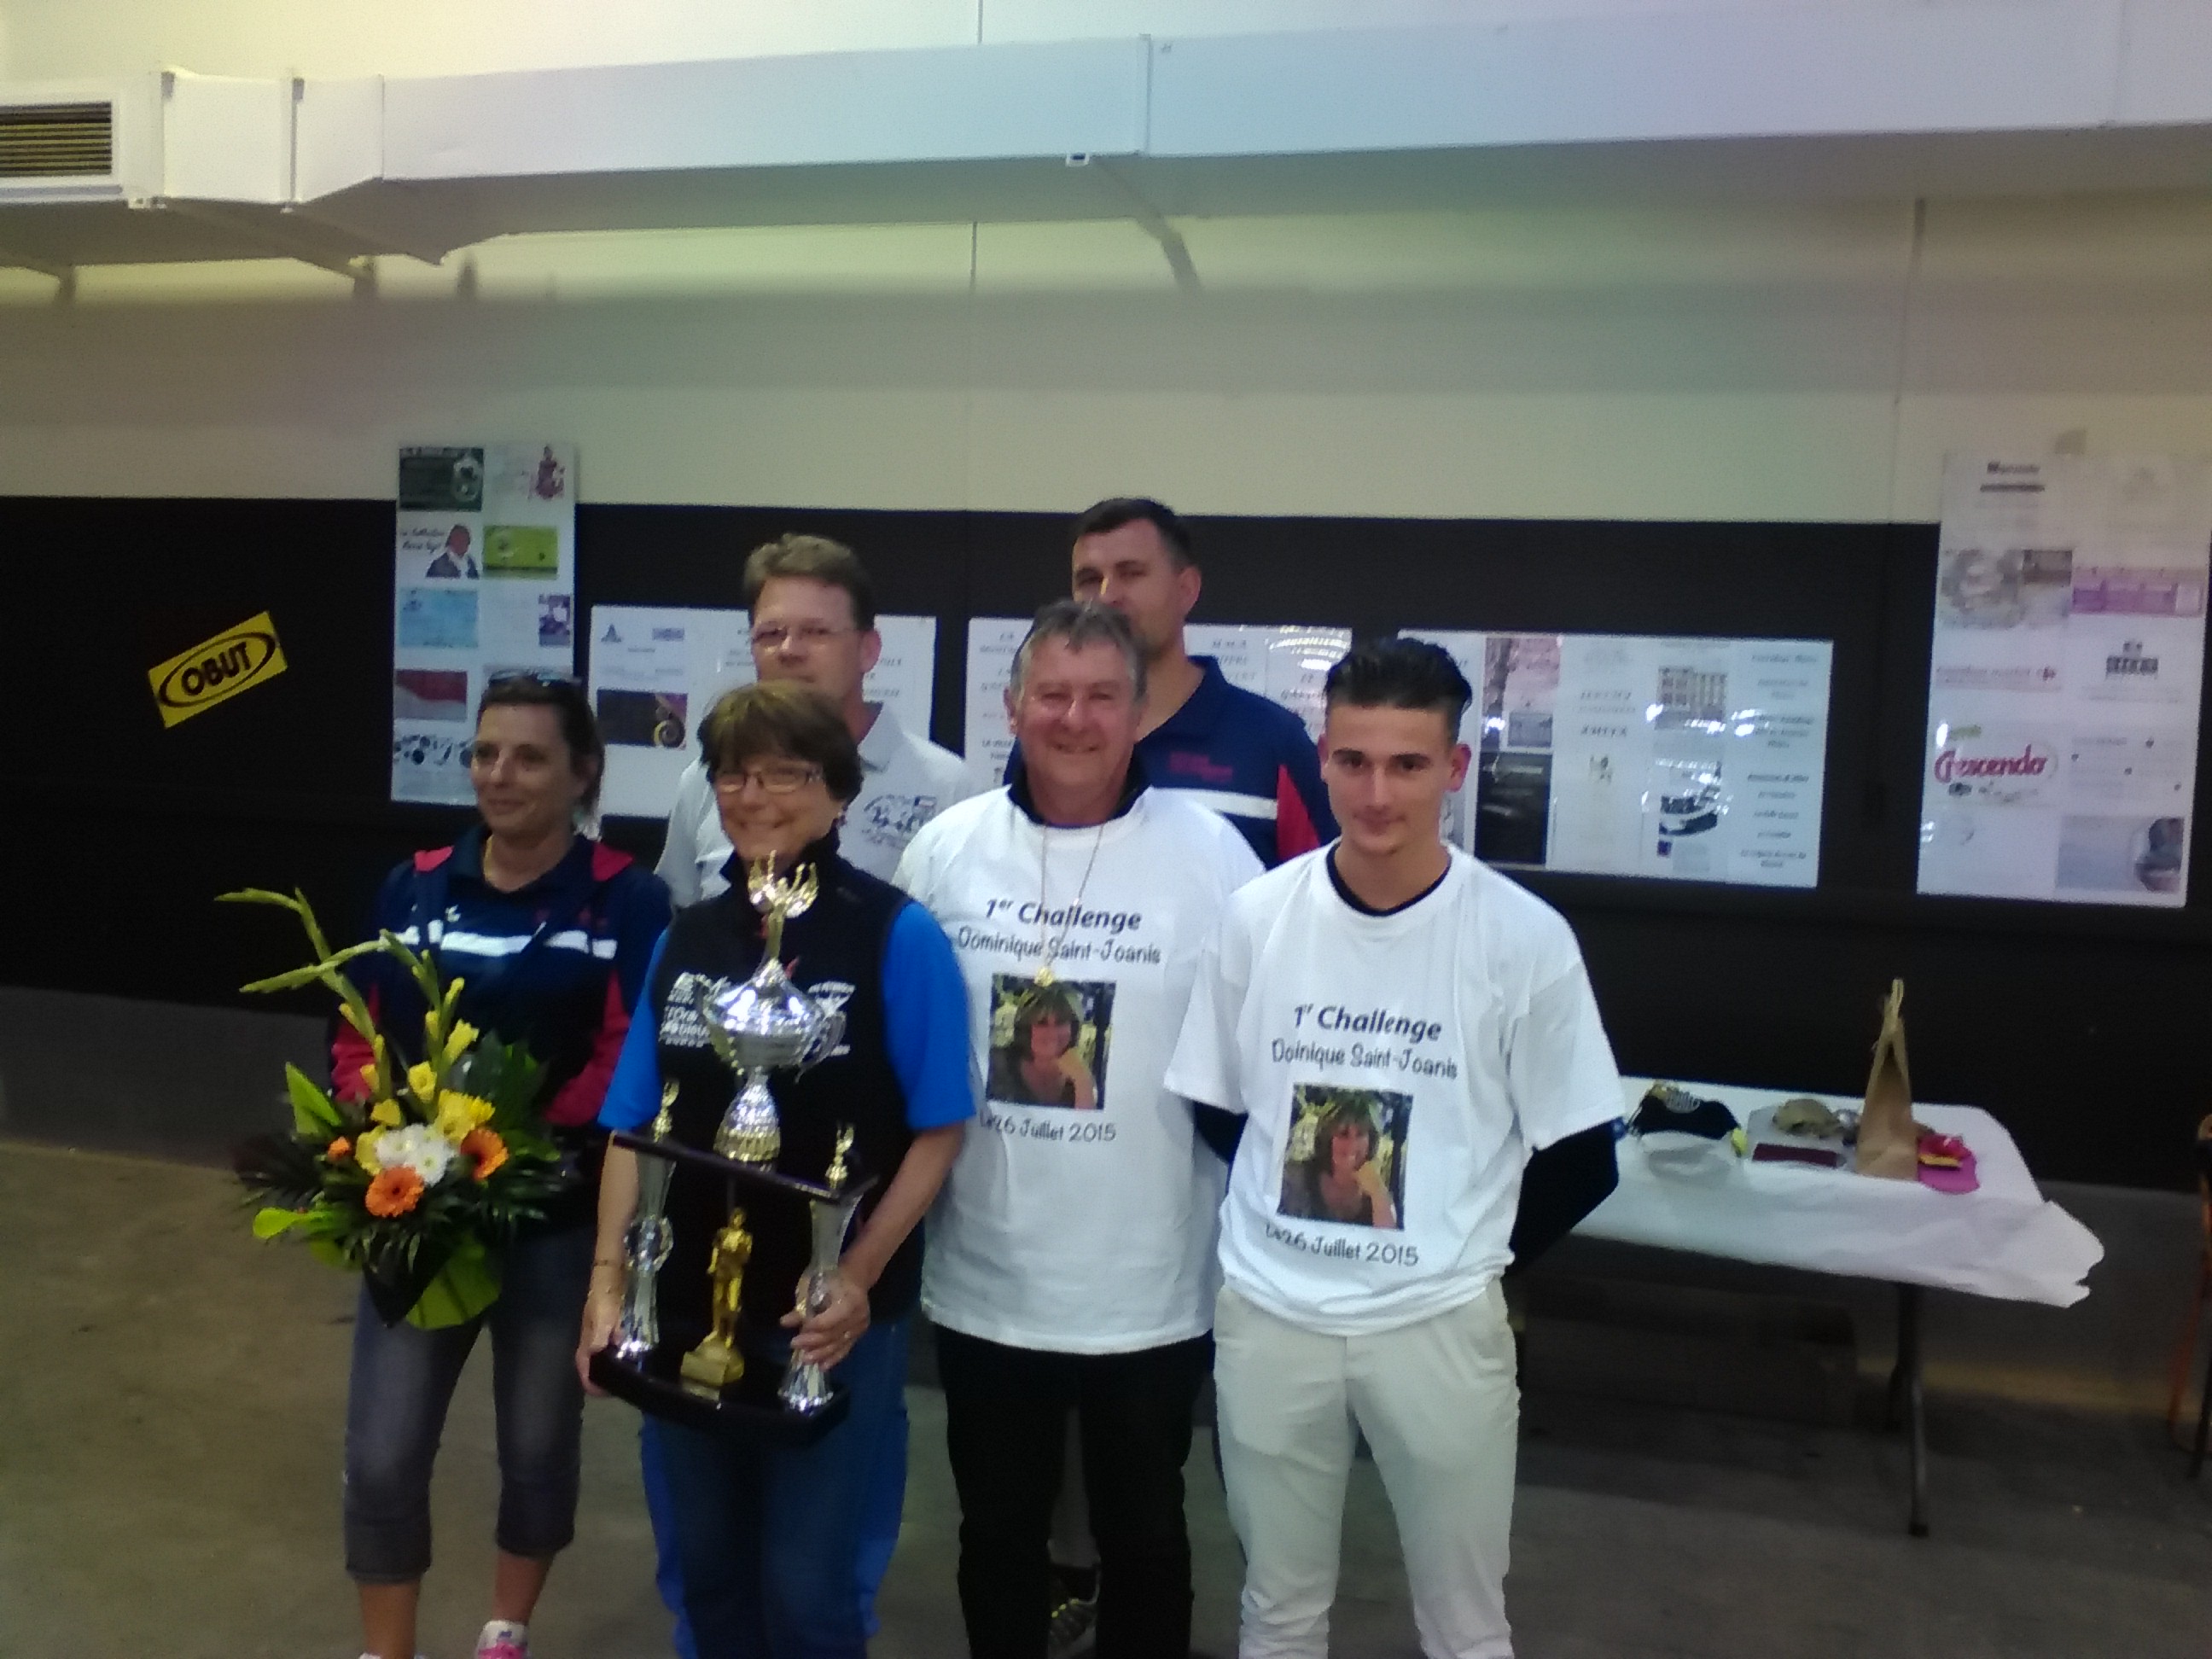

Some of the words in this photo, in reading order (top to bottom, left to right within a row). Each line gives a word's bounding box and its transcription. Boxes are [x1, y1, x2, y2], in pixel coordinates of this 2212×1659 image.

[181, 642, 251, 696] OBUT
[1018, 902, 1142, 934] Challenge
[958, 926, 1043, 961] Dominique
[1048, 936, 1161, 964] Saint-Joanis
[1318, 1005, 1442, 1045] Challenge
[1350, 1042, 1458, 1080] Saint-Joanis
[1020, 1118, 1064, 1141] Juillet
[1068, 1122, 1116, 1143] 2015
[1311, 1236, 1360, 1260] Juillet
[1365, 1242, 1419, 1266] 2015
